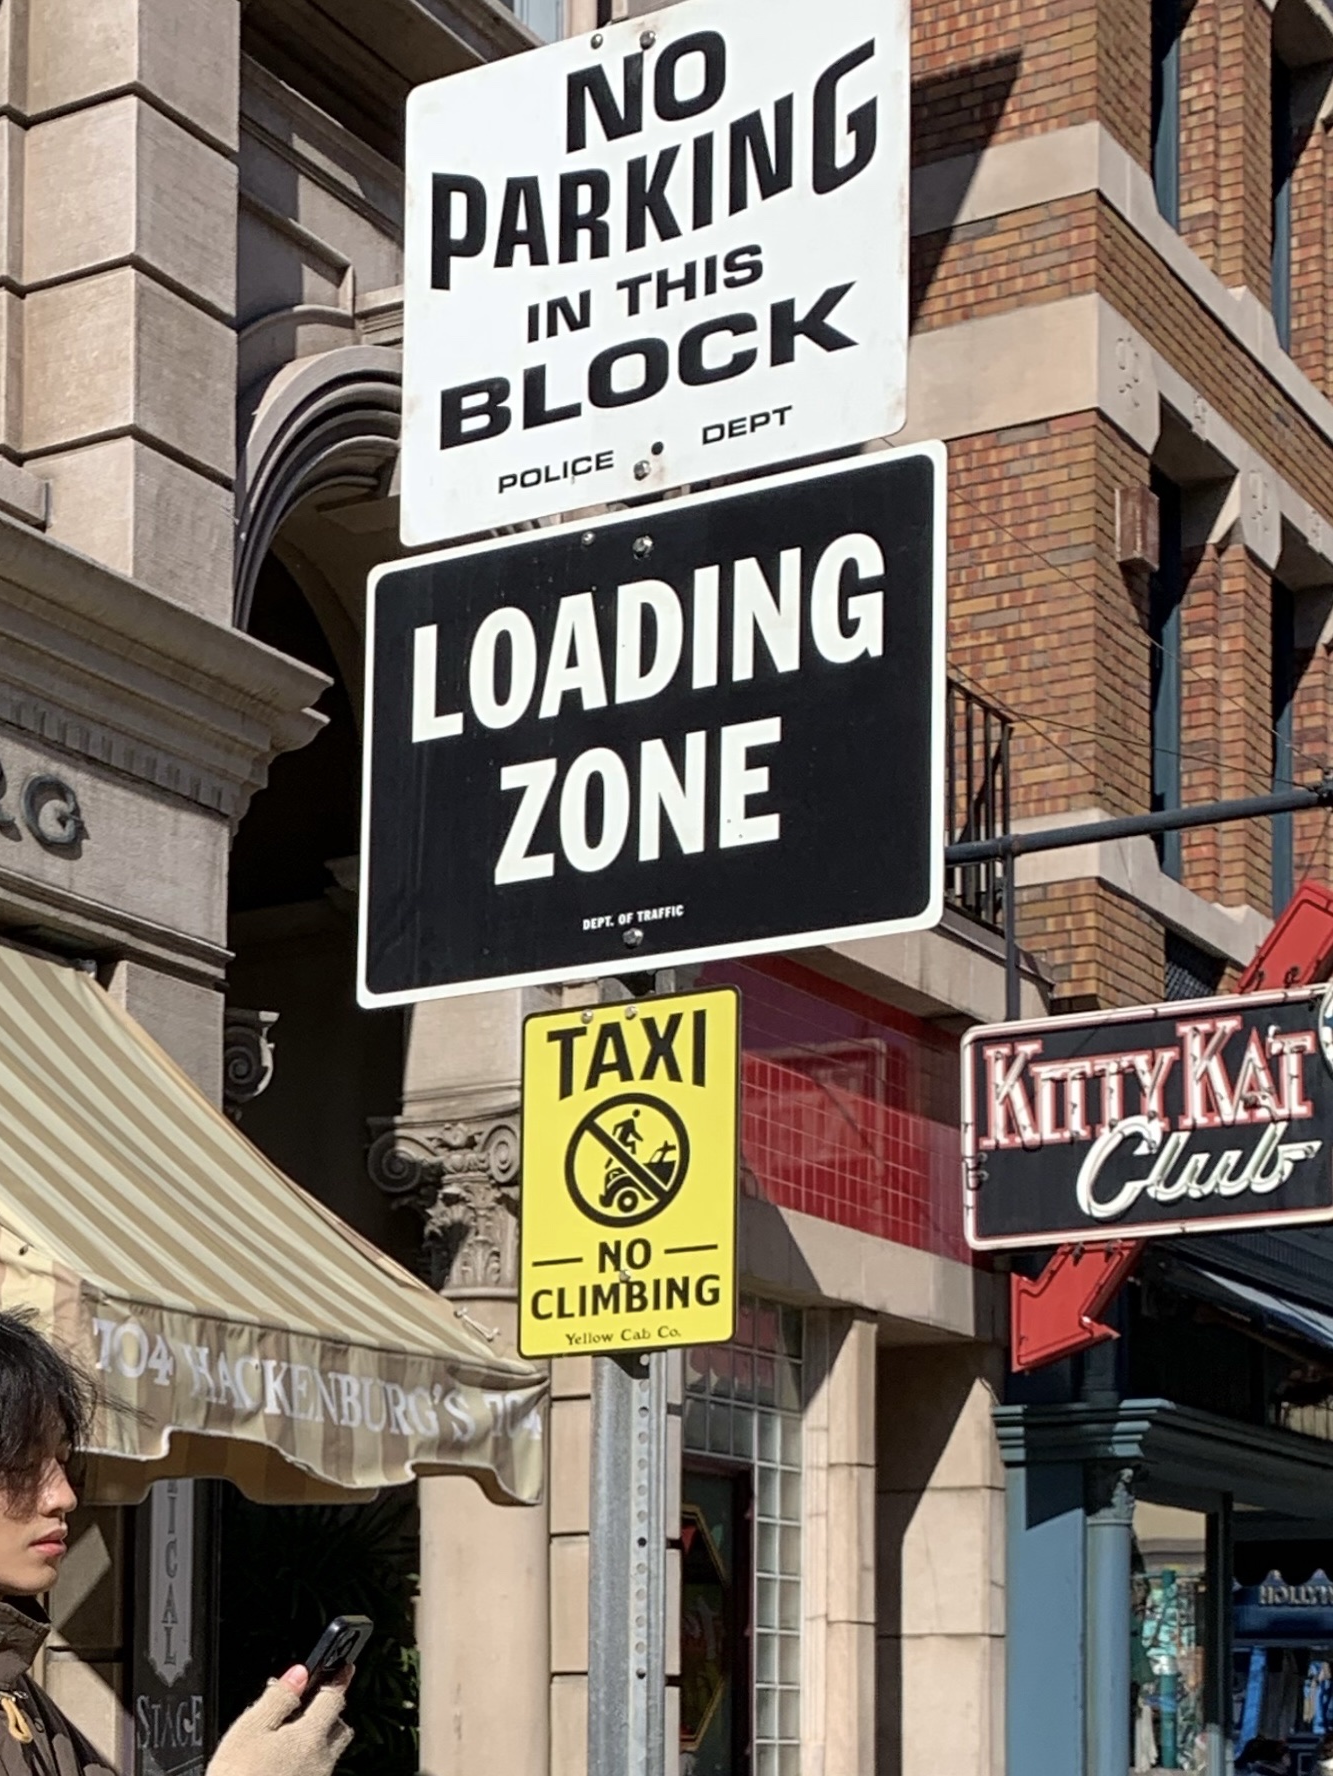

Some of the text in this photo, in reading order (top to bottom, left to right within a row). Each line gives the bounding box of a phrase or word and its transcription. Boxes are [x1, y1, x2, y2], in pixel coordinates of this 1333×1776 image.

[567, 30, 726, 154] NO
[431, 37, 878, 291] PARKING
[528, 244, 763, 343] IN THIS
[440, 281, 859, 450] BLOCK
[498, 405, 793, 494] POLICE DEPT
[411, 533, 885, 743] LOADING
[494, 716, 782, 886] ZONE
[582, 904, 685, 930] DEPT. OF TRAFFIC
[547, 1009, 706, 1101] TAXI
[1076, 1114, 1323, 1218] Club
[531, 1274, 721, 1320] CLIMBING
[598, 1238, 652, 1273] NO
[92, 1318, 174, 1386] 704
[182, 1340, 476, 1442] HACKENBURG'S
[565, 1325, 681, 1345] Yellow Cab Co.
